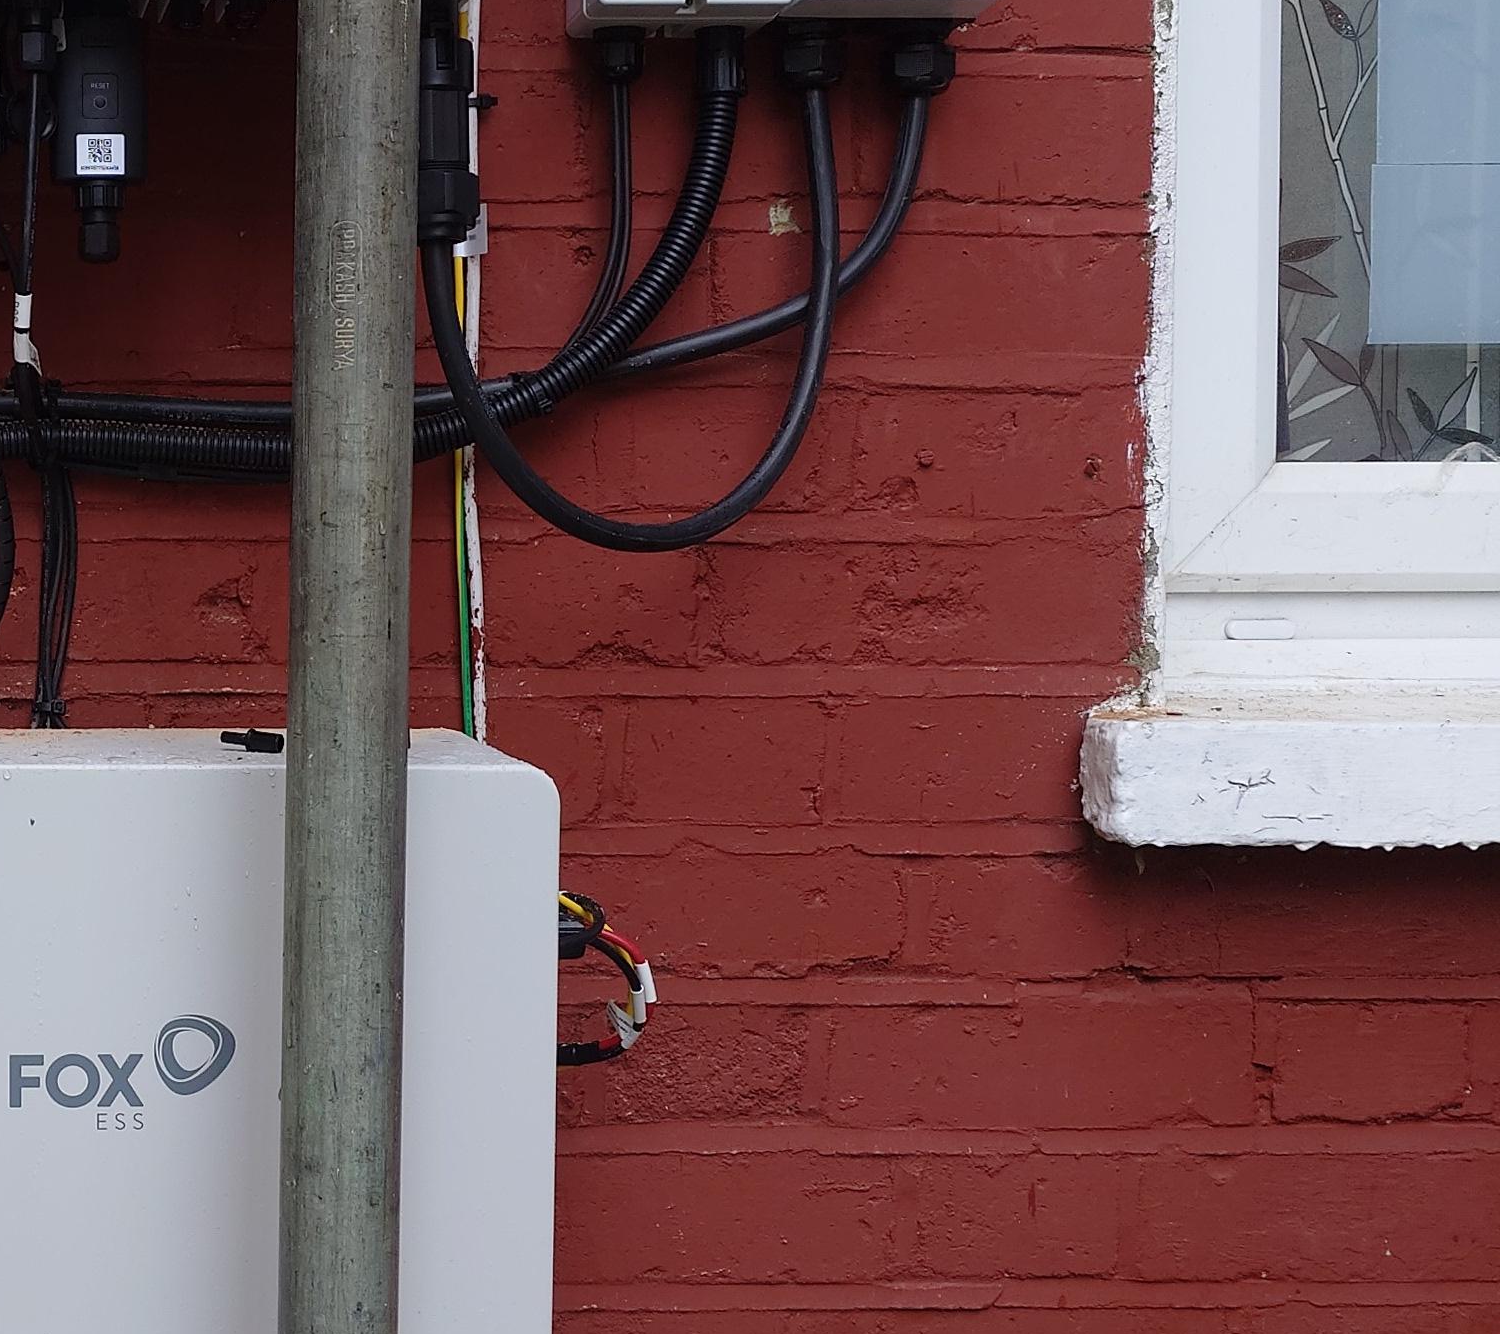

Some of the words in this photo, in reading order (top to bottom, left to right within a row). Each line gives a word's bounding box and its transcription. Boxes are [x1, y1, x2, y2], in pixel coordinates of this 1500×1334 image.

[334, 317, 356, 372] SURYA
[8, 1052, 145, 1109] FOX
[96, 1113, 145, 1131] ESS
